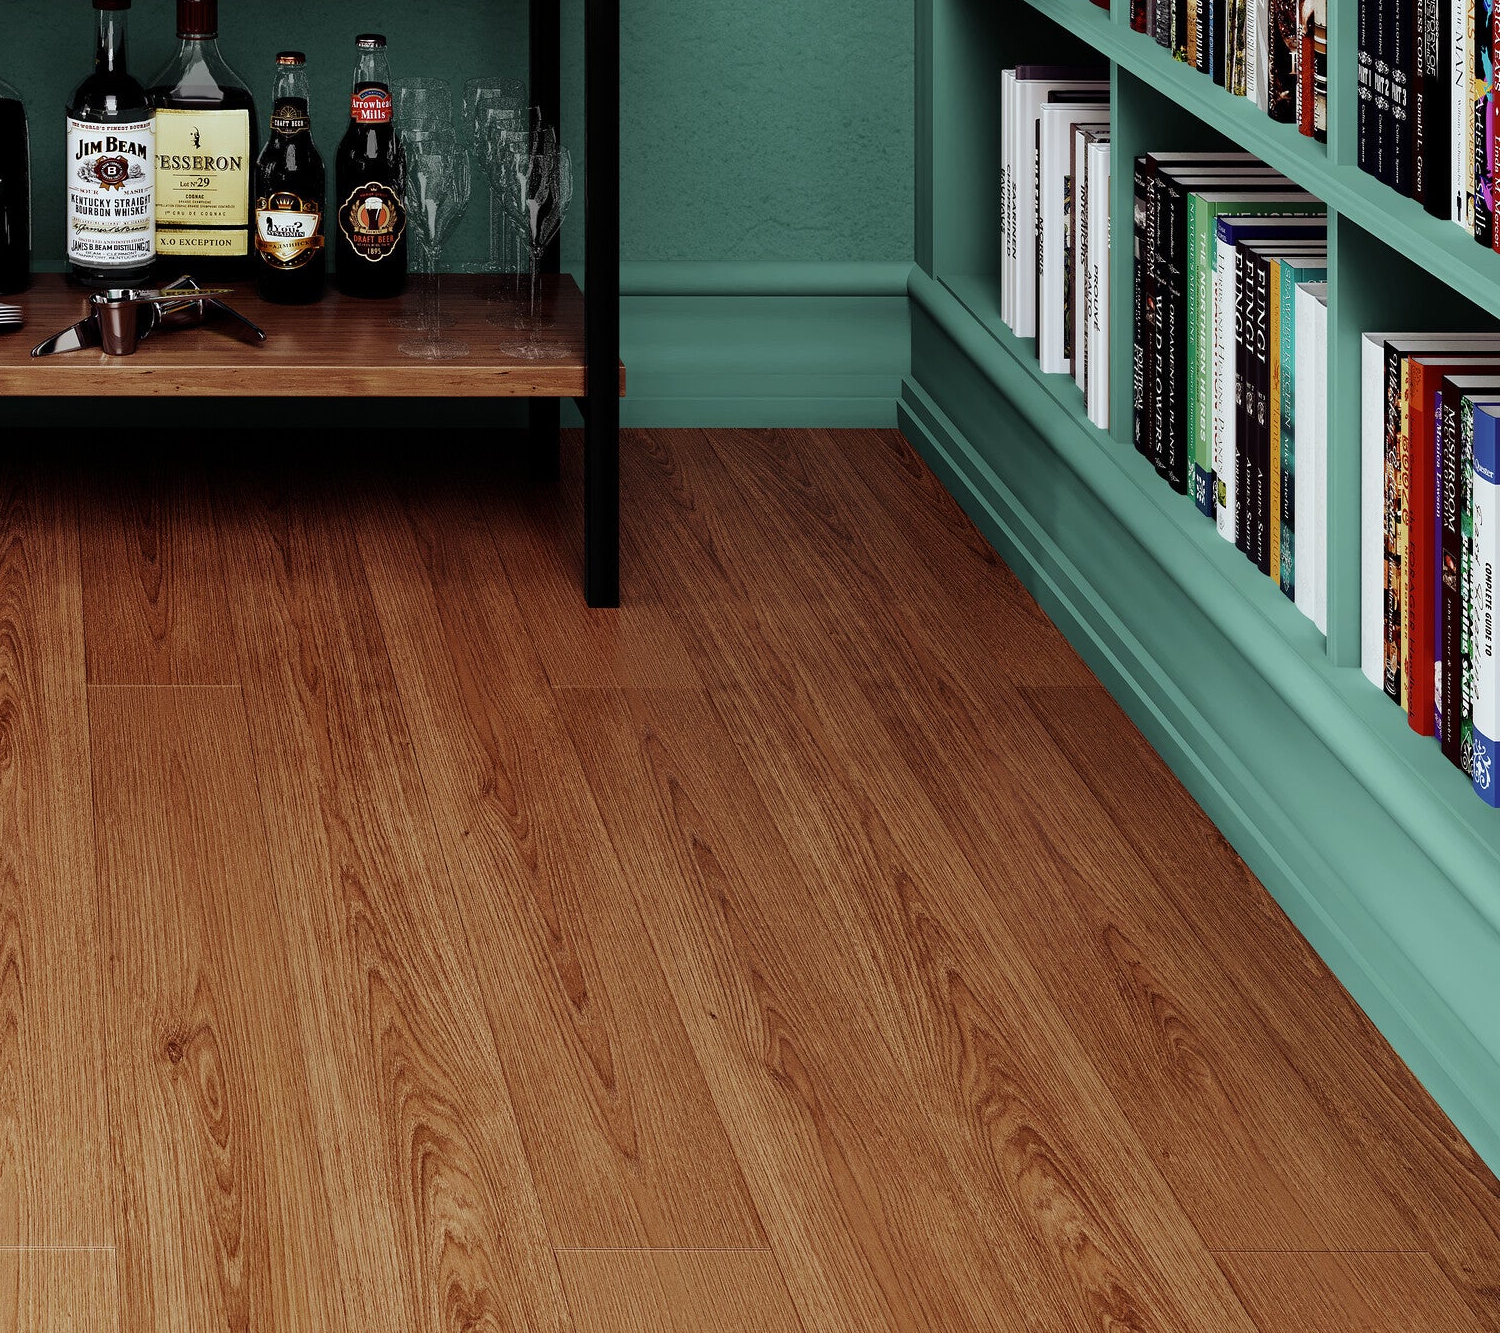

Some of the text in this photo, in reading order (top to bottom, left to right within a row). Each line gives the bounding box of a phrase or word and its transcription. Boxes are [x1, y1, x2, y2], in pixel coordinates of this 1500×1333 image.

[361, 110, 386, 120] Mills
[76, 136, 147, 161] JIM BEAM
[107, 166, 116, 176] B
[1476, 99, 1485, 236] Artistic Skills
[71, 194, 151, 208] KENTUCKY STRAIGHT
[123, 188, 144, 196] MASH
[76, 205, 111, 217] BOURBON
[114, 205, 148, 217] WHISKEY
[1148, 177, 1156, 279] MUSHROOM
[160, 238, 232, 247] X.O EXCEPTION
[354, 234, 395, 244] DRAFT BEER
[367, 247, 383, 255] 1895
[1235, 253, 1243, 344] FUNGI
[1245, 260, 1254, 354] FUNGI
[1257, 270, 1265, 364] FUNGI
[1155, 294, 1163, 453] WILD FLOWERS
[1387, 352, 1397, 436] Whiskey
[1448, 407, 1456, 533] MUSHROOM
[1485, 642, 1492, 657] TO
